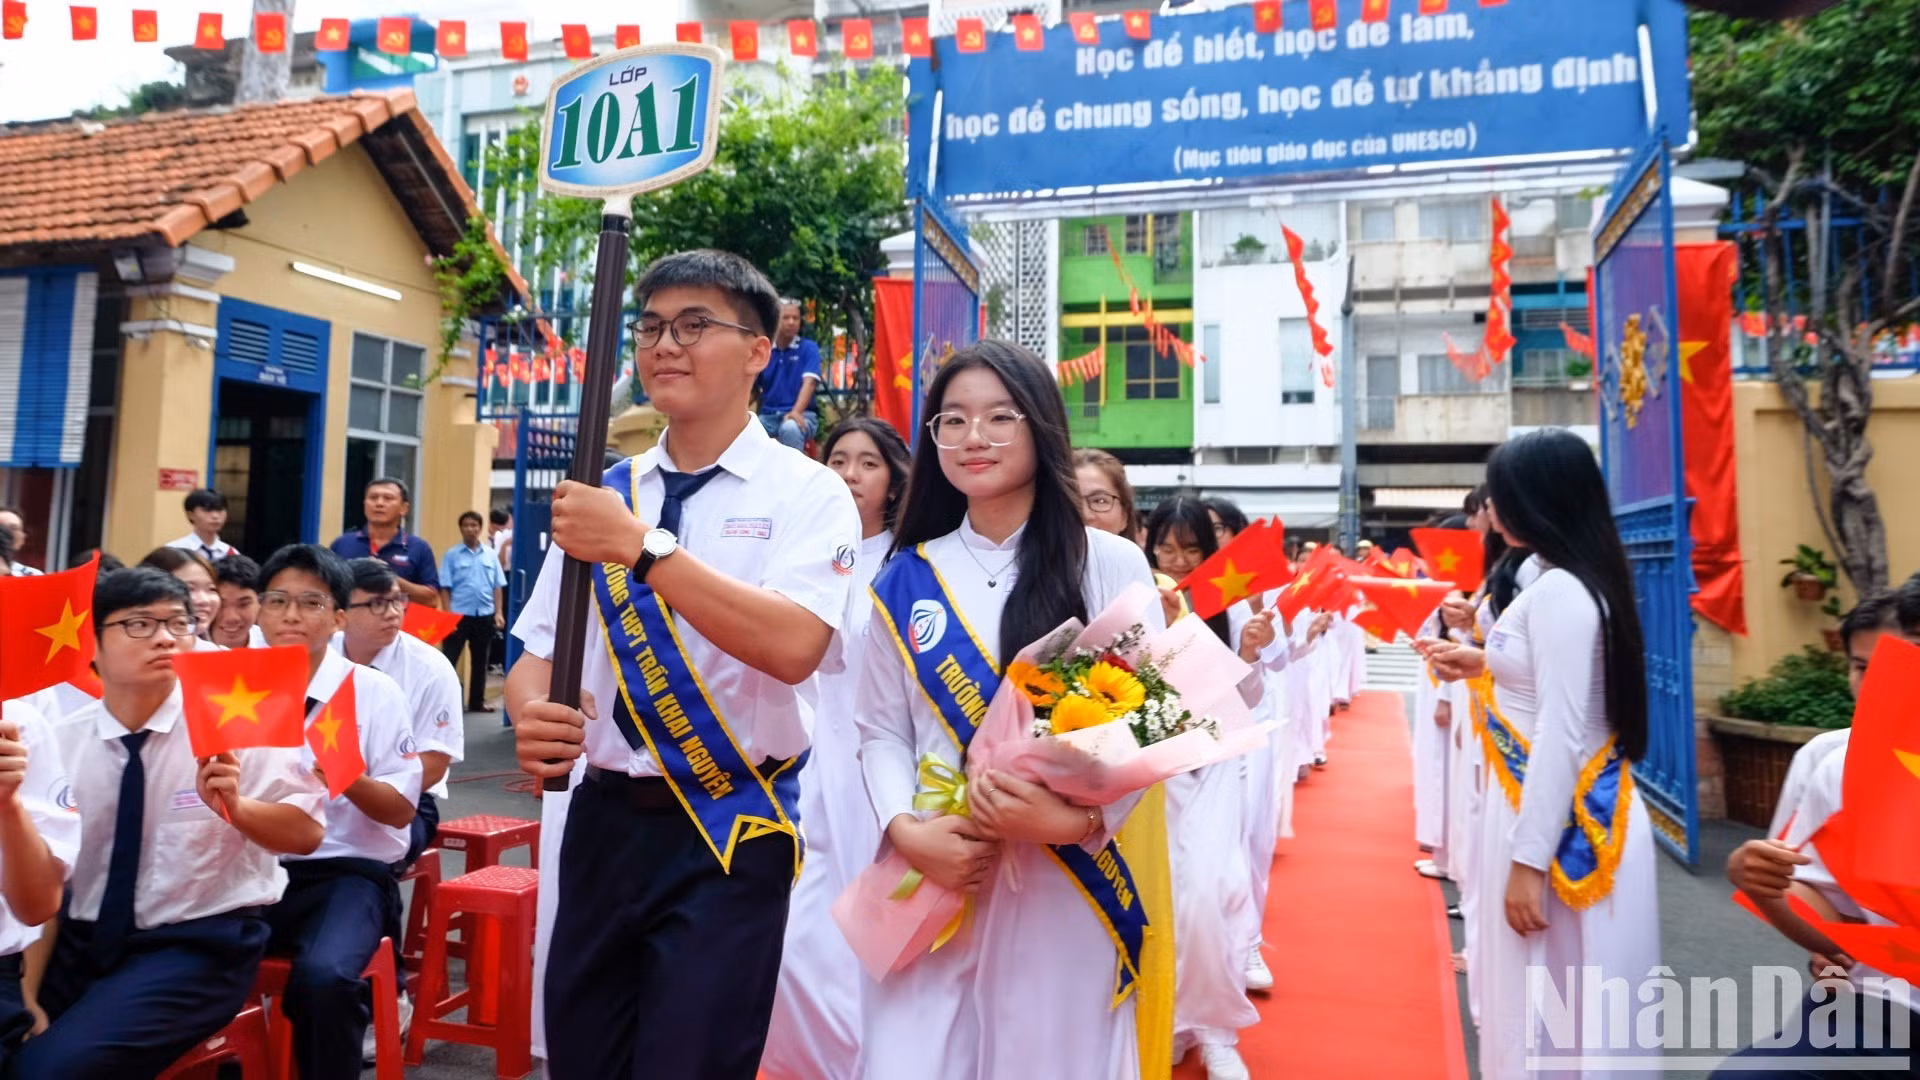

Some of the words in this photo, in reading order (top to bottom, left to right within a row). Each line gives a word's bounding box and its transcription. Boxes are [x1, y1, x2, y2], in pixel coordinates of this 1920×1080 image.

[609, 65, 647, 86] LỚP
[1076, 47, 1135, 79] Học
[1143, 31, 1184, 69] để
[1193, 26, 1265, 65] biết,
[552, 74, 699, 170] 10A1
[946, 112, 1000, 144] học
[1008, 98, 1046, 135] để
[1055, 100, 1152, 132] chung
[1161, 86, 1249, 123] sống,
[1258, 84, 1322, 119] học
[1330, 69, 1375, 108] để
[1383, 71, 1424, 109] tự
[1429, 58, 1543, 100] khẳng
[1551, 53, 1638, 94] định
[1174, 144, 1221, 174] (Mục
[1226, 143, 1262, 166] tiêu
[1266, 140, 1307, 165] giáo
[1311, 138, 1347, 163] dục
[1351, 132, 1387, 156] của
[1391, 121, 1478, 153] UNESCO)
[601, 562, 630, 608] ƯỜNG
[620, 601, 648, 649] THPT
[634, 643, 670, 697] TRẦN
[653, 692, 694, 739] KHAI
[679, 735, 734, 801] NGUYÊN
